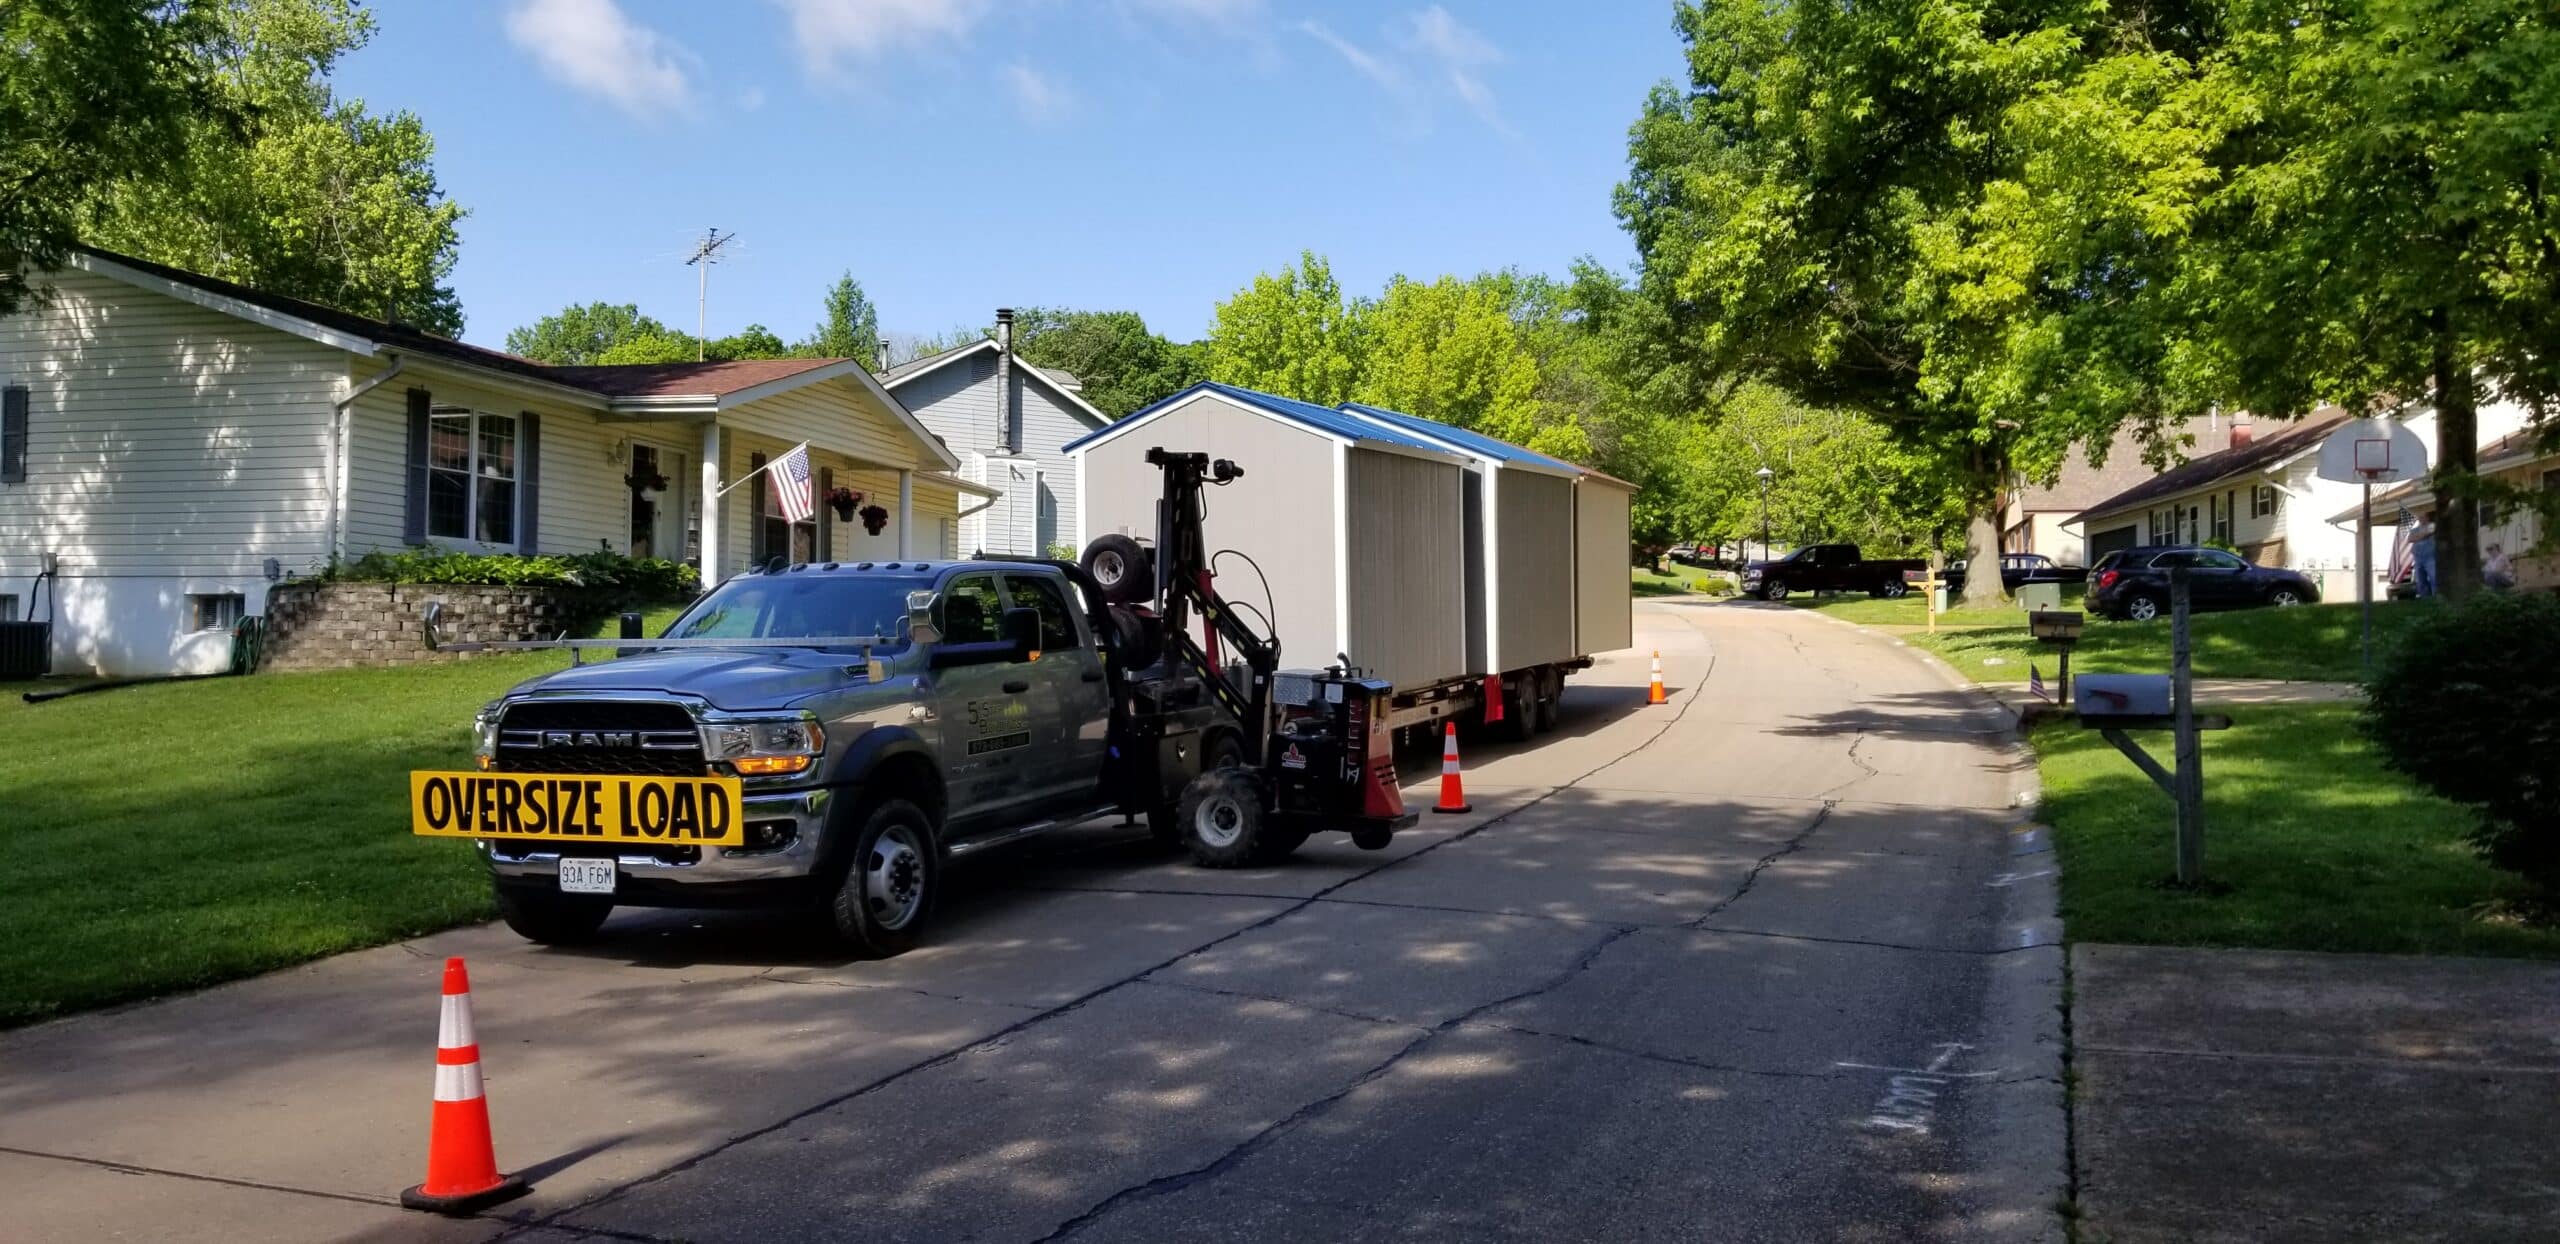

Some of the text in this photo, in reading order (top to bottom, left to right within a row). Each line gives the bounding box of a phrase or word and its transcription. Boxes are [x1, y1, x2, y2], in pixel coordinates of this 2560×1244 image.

[546, 733, 633, 747] RAM
[422, 777, 730, 839] OVERSIZE LOAD
[562, 866, 612, 884] 93A F6M
